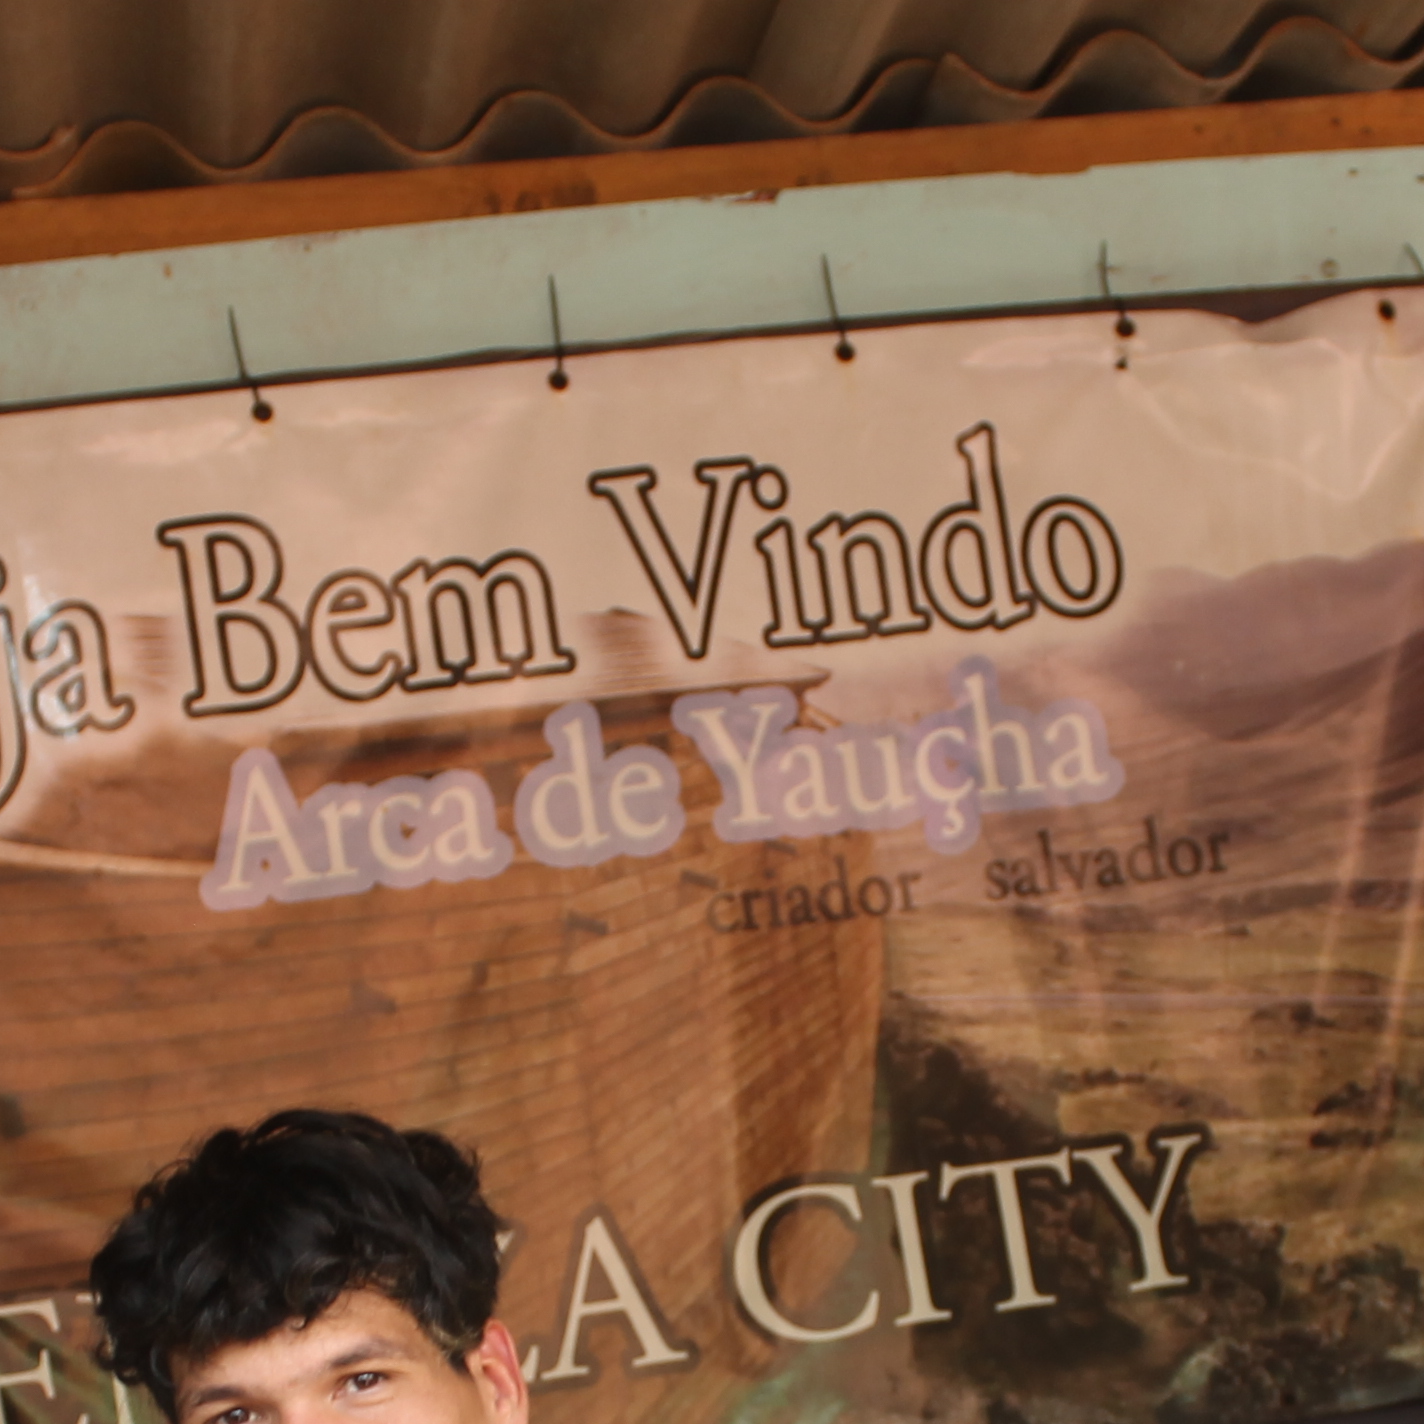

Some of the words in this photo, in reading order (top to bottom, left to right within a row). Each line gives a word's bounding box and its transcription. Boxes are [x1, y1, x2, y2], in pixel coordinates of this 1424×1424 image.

[156, 513, 576, 717] Bem
[587, 421, 1123, 659] Vindo
[212, 758, 502, 899] Arca
[523, 711, 675, 856] de
[707, 855, 921, 934] criador
[985, 816, 1230, 901] salvador
[733, 1134, 1202, 1343] CITY
